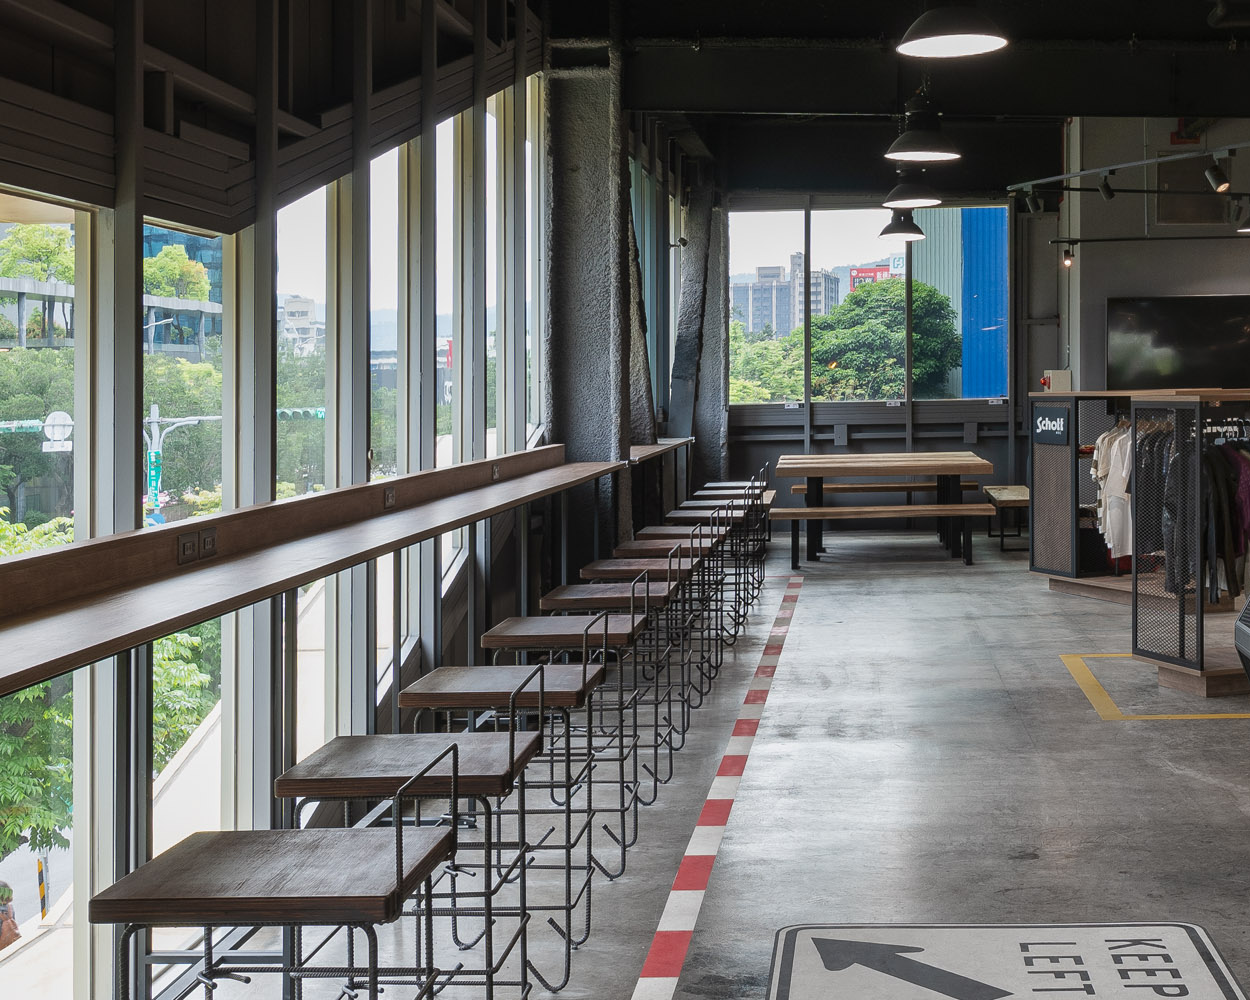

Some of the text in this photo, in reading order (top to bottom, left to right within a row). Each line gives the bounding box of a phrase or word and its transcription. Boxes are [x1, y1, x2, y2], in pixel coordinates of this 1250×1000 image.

[1036, 416, 1065, 433] Schott
[1019, 941, 1096, 995] LEFT
[1104, 938, 1190, 998] KEEP
